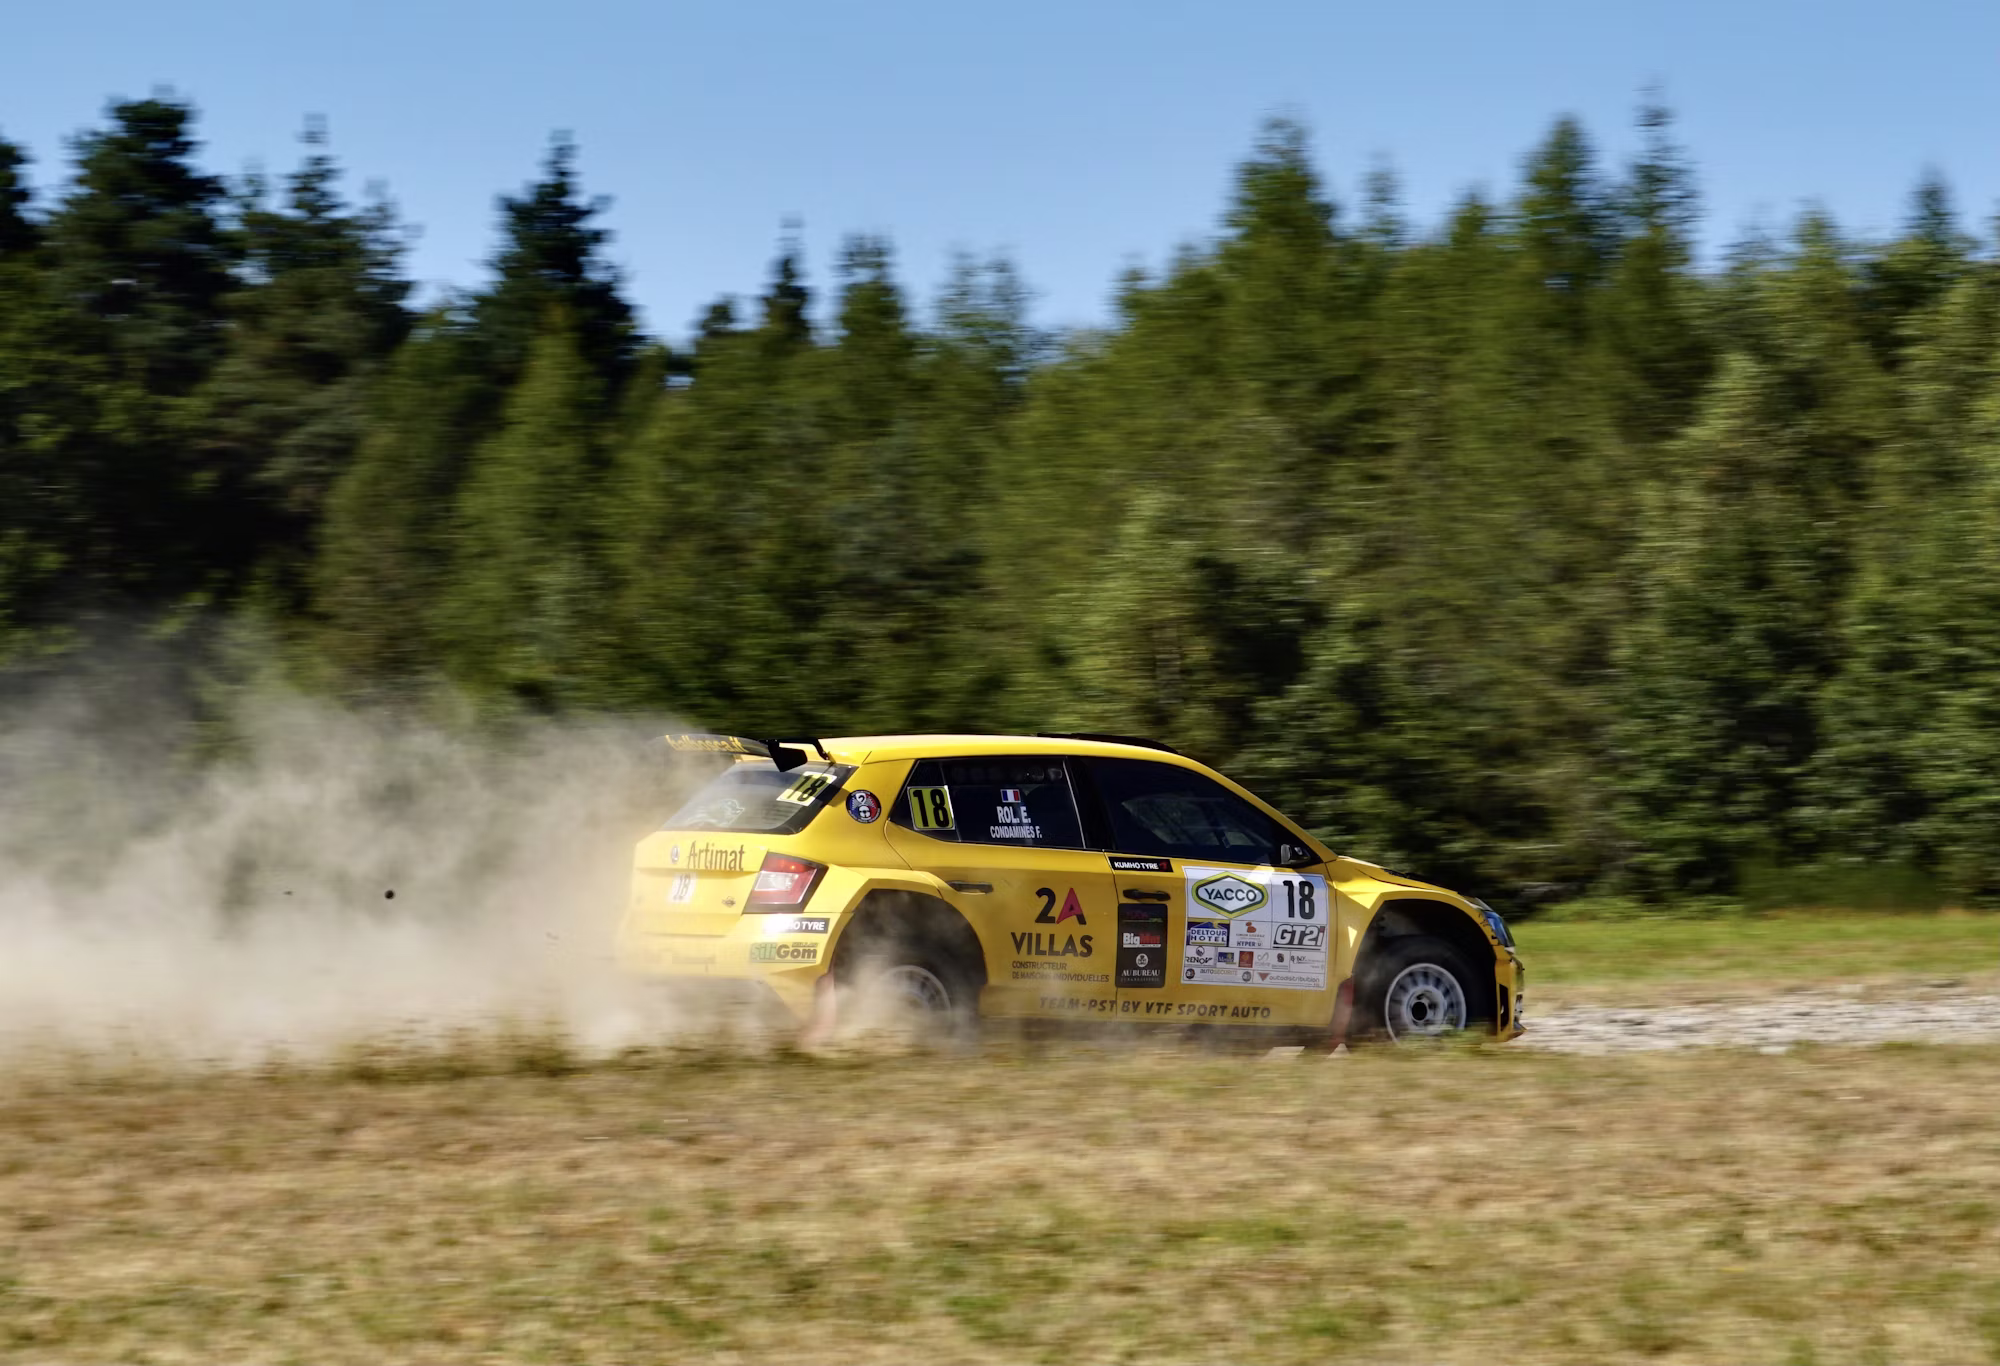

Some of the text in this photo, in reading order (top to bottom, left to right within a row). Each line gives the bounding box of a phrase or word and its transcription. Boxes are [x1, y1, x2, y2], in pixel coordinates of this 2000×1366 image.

[786, 773, 828, 802] 18
[912, 788, 950, 828] 18
[1020, 806, 1031, 823] E.
[990, 826, 1043, 838] CONDAMINES F.
[687, 840, 746, 871] Artimat
[1114, 861, 1159, 870] KUMHO TYRE
[1204, 888, 1257, 902] YACCO
[1283, 880, 1315, 920] 18
[1034, 887, 1087, 925] 2A
[802, 921, 825, 930] TYRE
[1190, 929, 1227, 937] DELTOUR
[1010, 931, 1094, 957] VILLAS
[1189, 935, 1227, 943] HOTEL
[1012, 961, 1067, 971] CONSTRUCTEUR
[1012, 971, 1020, 979] DE
[1053, 973, 1110, 983] INDIVIDUELLES
[1121, 1001, 1141, 1013] BY
[1145, 1002, 1173, 1014] VTF
[1177, 1003, 1228, 1016] SPORT
[1231, 1006, 1271, 1018] AUTO
